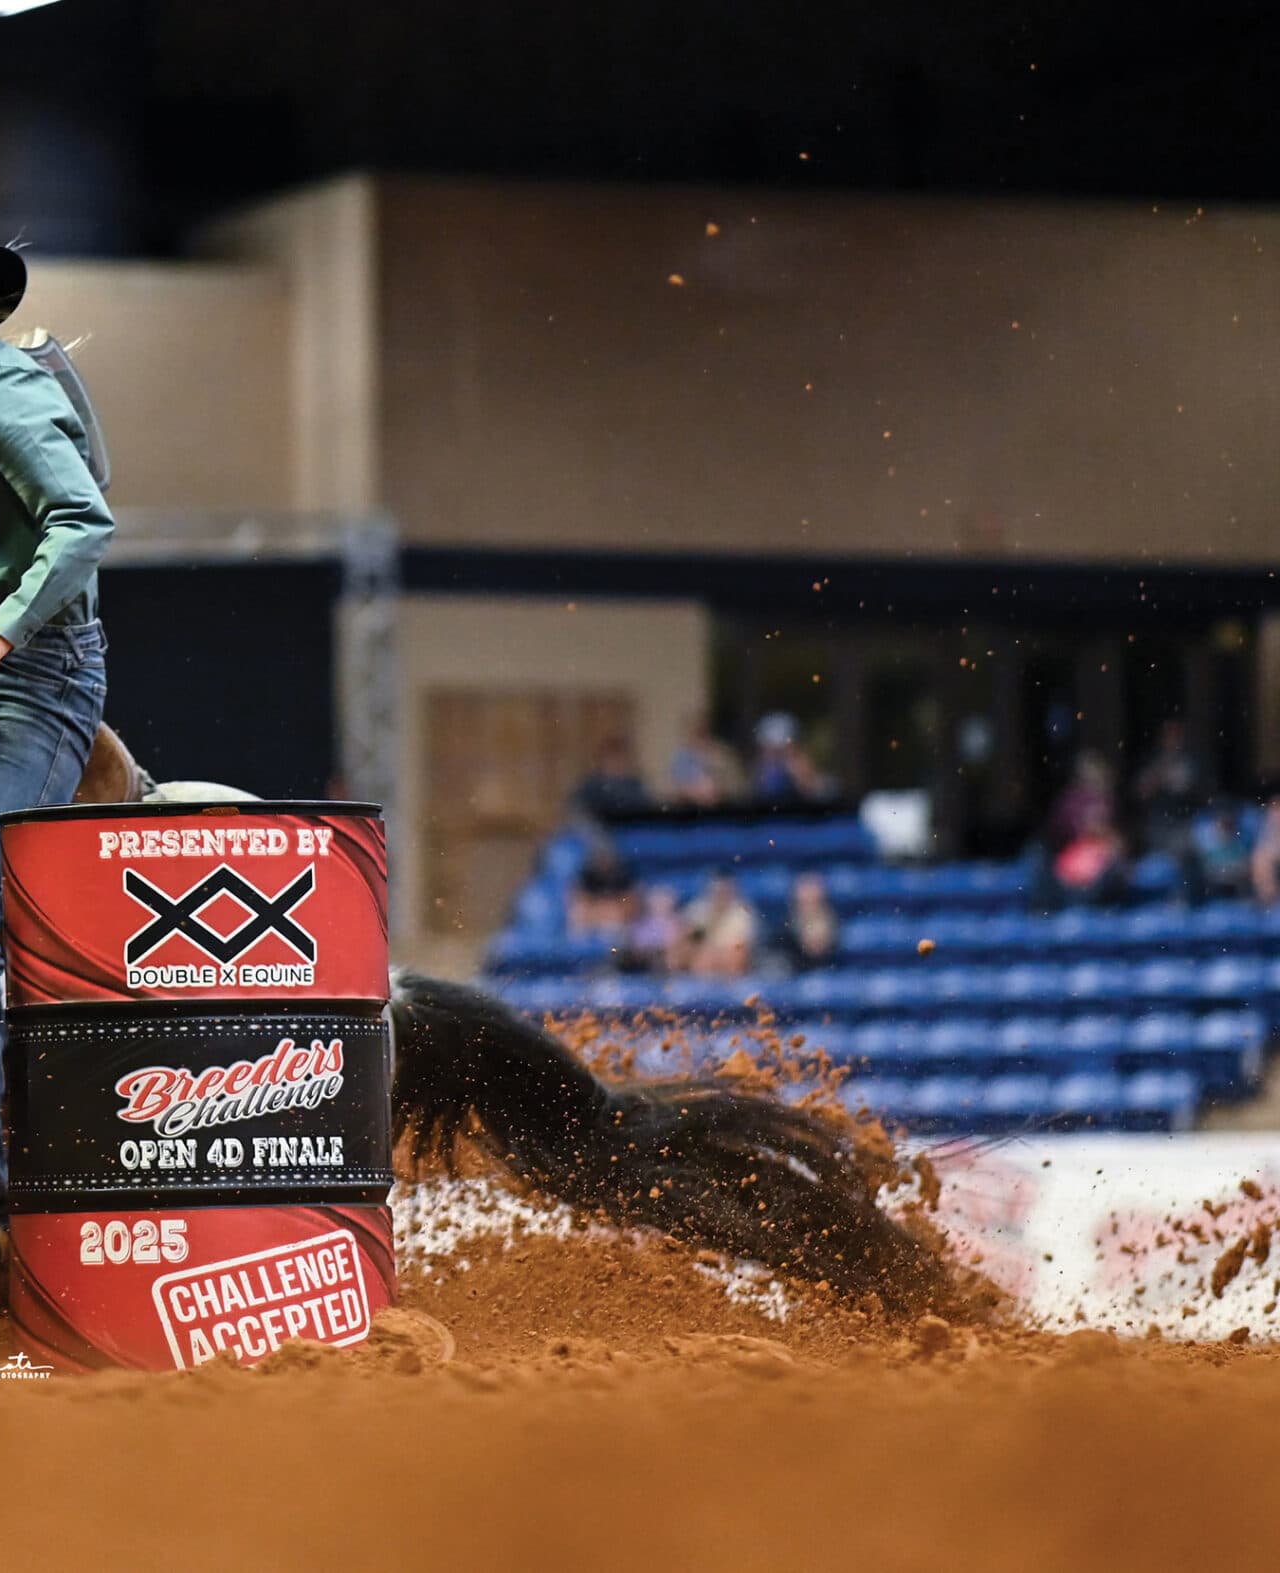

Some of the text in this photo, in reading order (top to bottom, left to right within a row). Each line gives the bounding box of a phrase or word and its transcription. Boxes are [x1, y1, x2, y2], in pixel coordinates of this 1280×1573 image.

[99, 828, 333, 858] PRESENTED BY
[128, 966, 314, 986] DOUBLE X EQUINE
[117, 1039, 343, 1121] Breeders
[156, 1074, 343, 1136] Challenge
[120, 1136, 344, 1169] OPEN 4D FINALE
[80, 1219, 189, 1264] 2025
[169, 1243, 354, 1323] CHALLENGE
[188, 1288, 362, 1366] ACCEPTED
